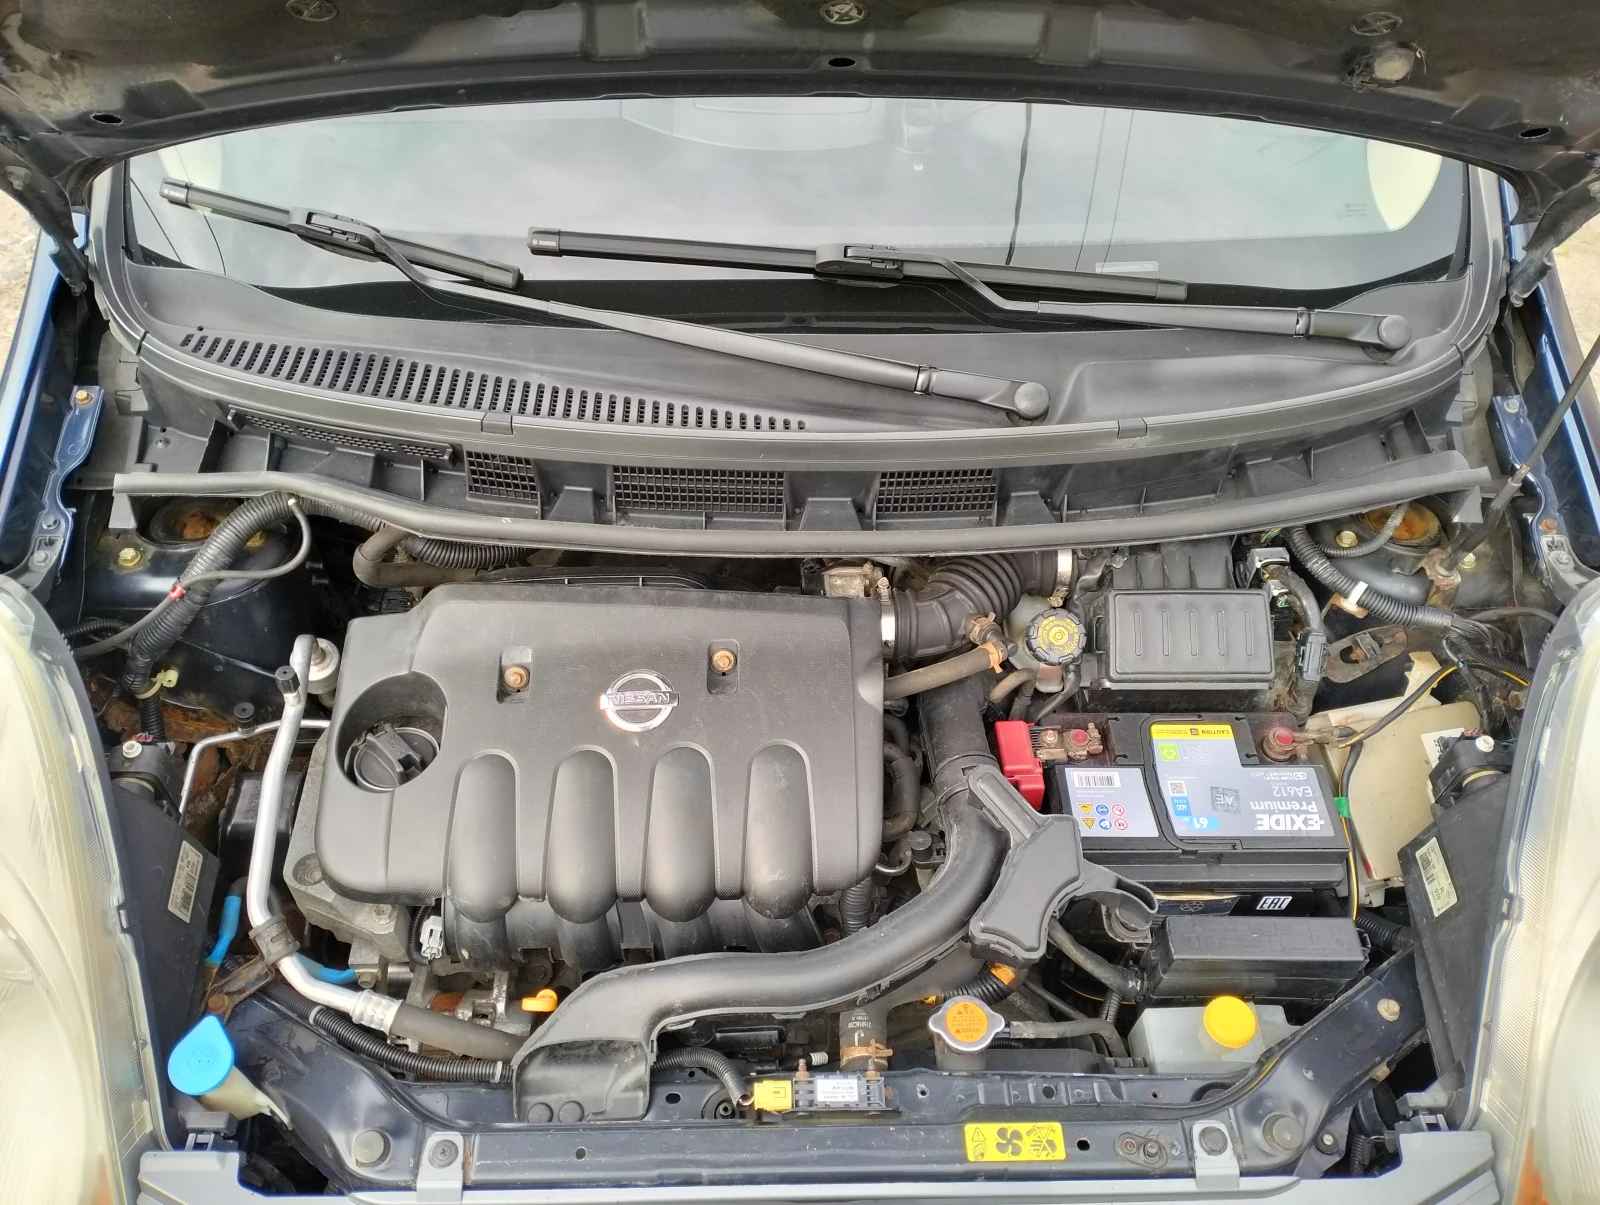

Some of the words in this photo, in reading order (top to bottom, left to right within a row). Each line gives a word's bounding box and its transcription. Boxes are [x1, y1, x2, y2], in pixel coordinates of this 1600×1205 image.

[608, 692, 670, 705] NISSAN
[1272, 786, 1313, 796] EA612
[1216, 794, 1234, 805] AE
[1250, 800, 1317, 813] Premium
[1193, 817, 1208, 828] 61
[1256, 814, 1321, 830] EXIDE
[1259, 898, 1290, 909] EAC
[854, 1029, 864, 1046] J
